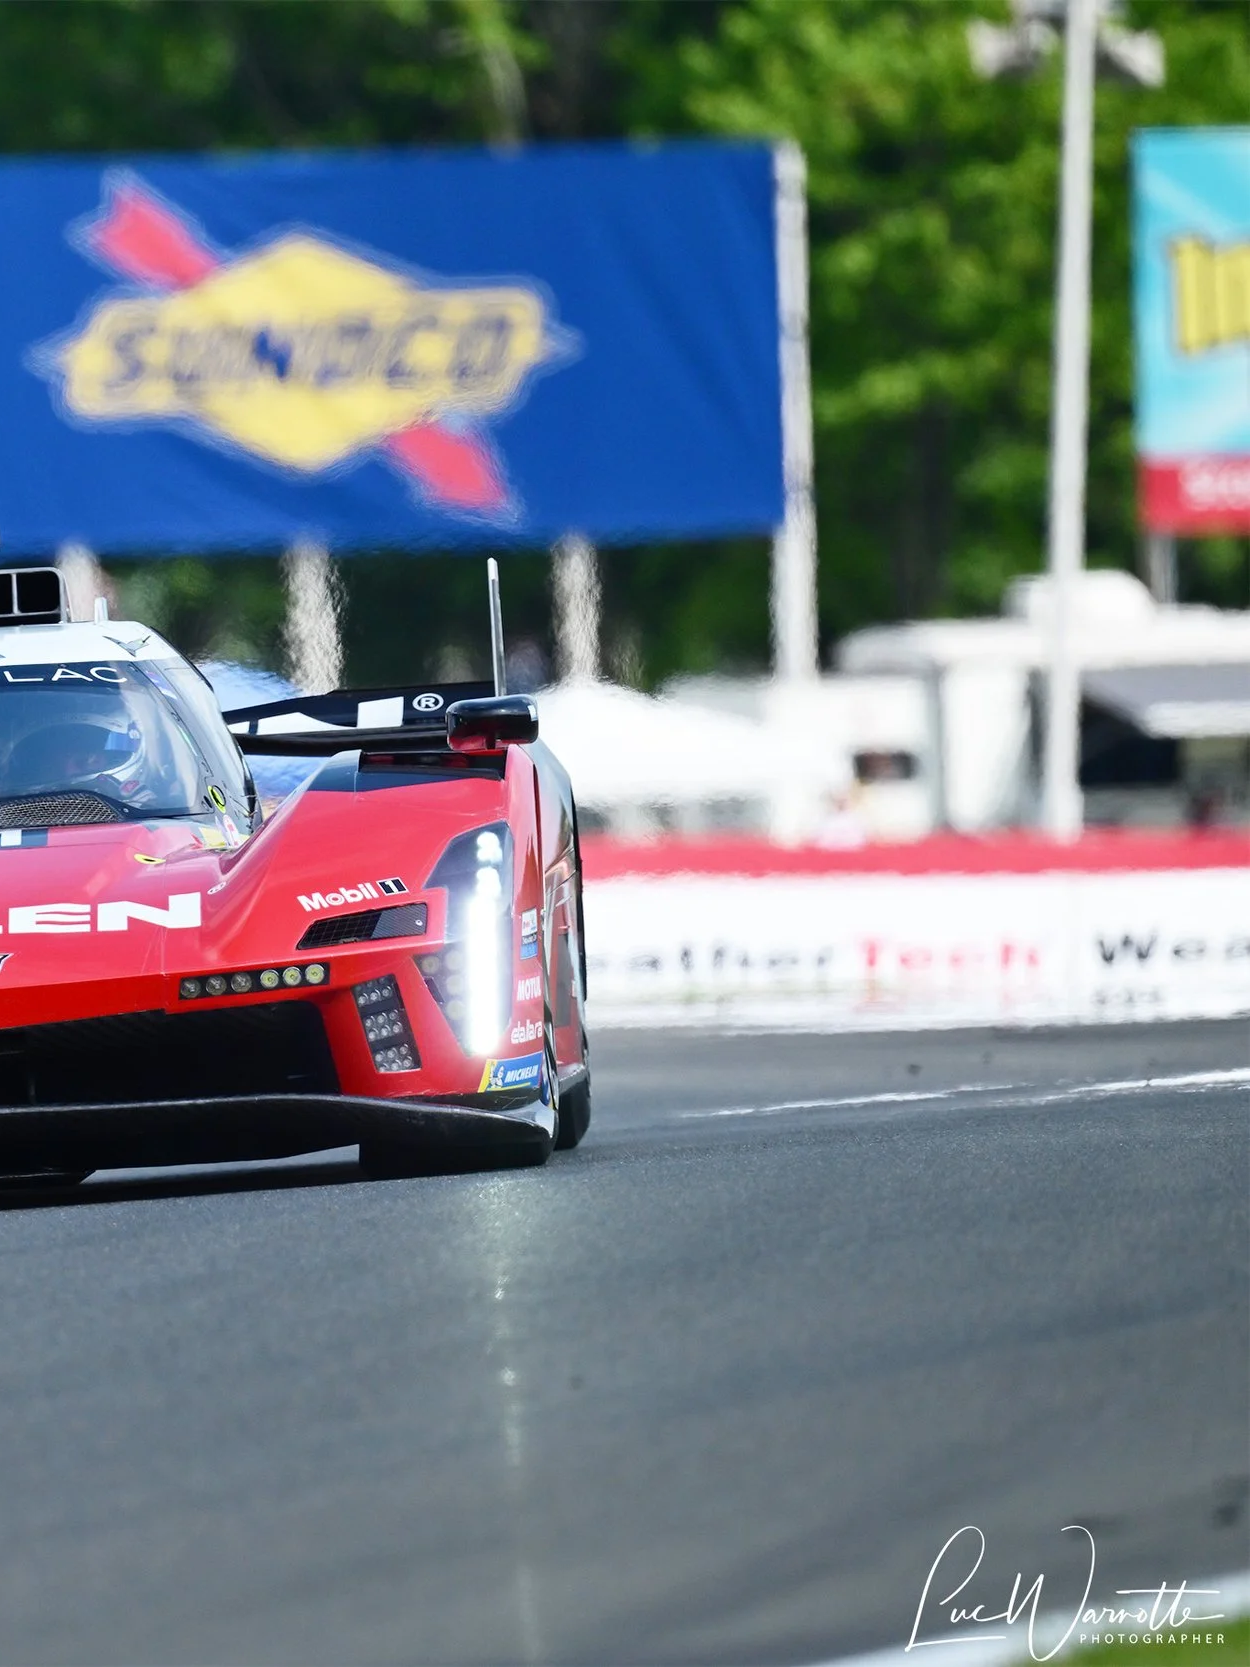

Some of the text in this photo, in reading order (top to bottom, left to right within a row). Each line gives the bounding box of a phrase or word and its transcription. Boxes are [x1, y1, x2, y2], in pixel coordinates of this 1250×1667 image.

[297, 882, 379, 912] Mobil
[517, 976, 541, 1001] MOTUL
[504, 1065, 539, 1083] MICHELIN
